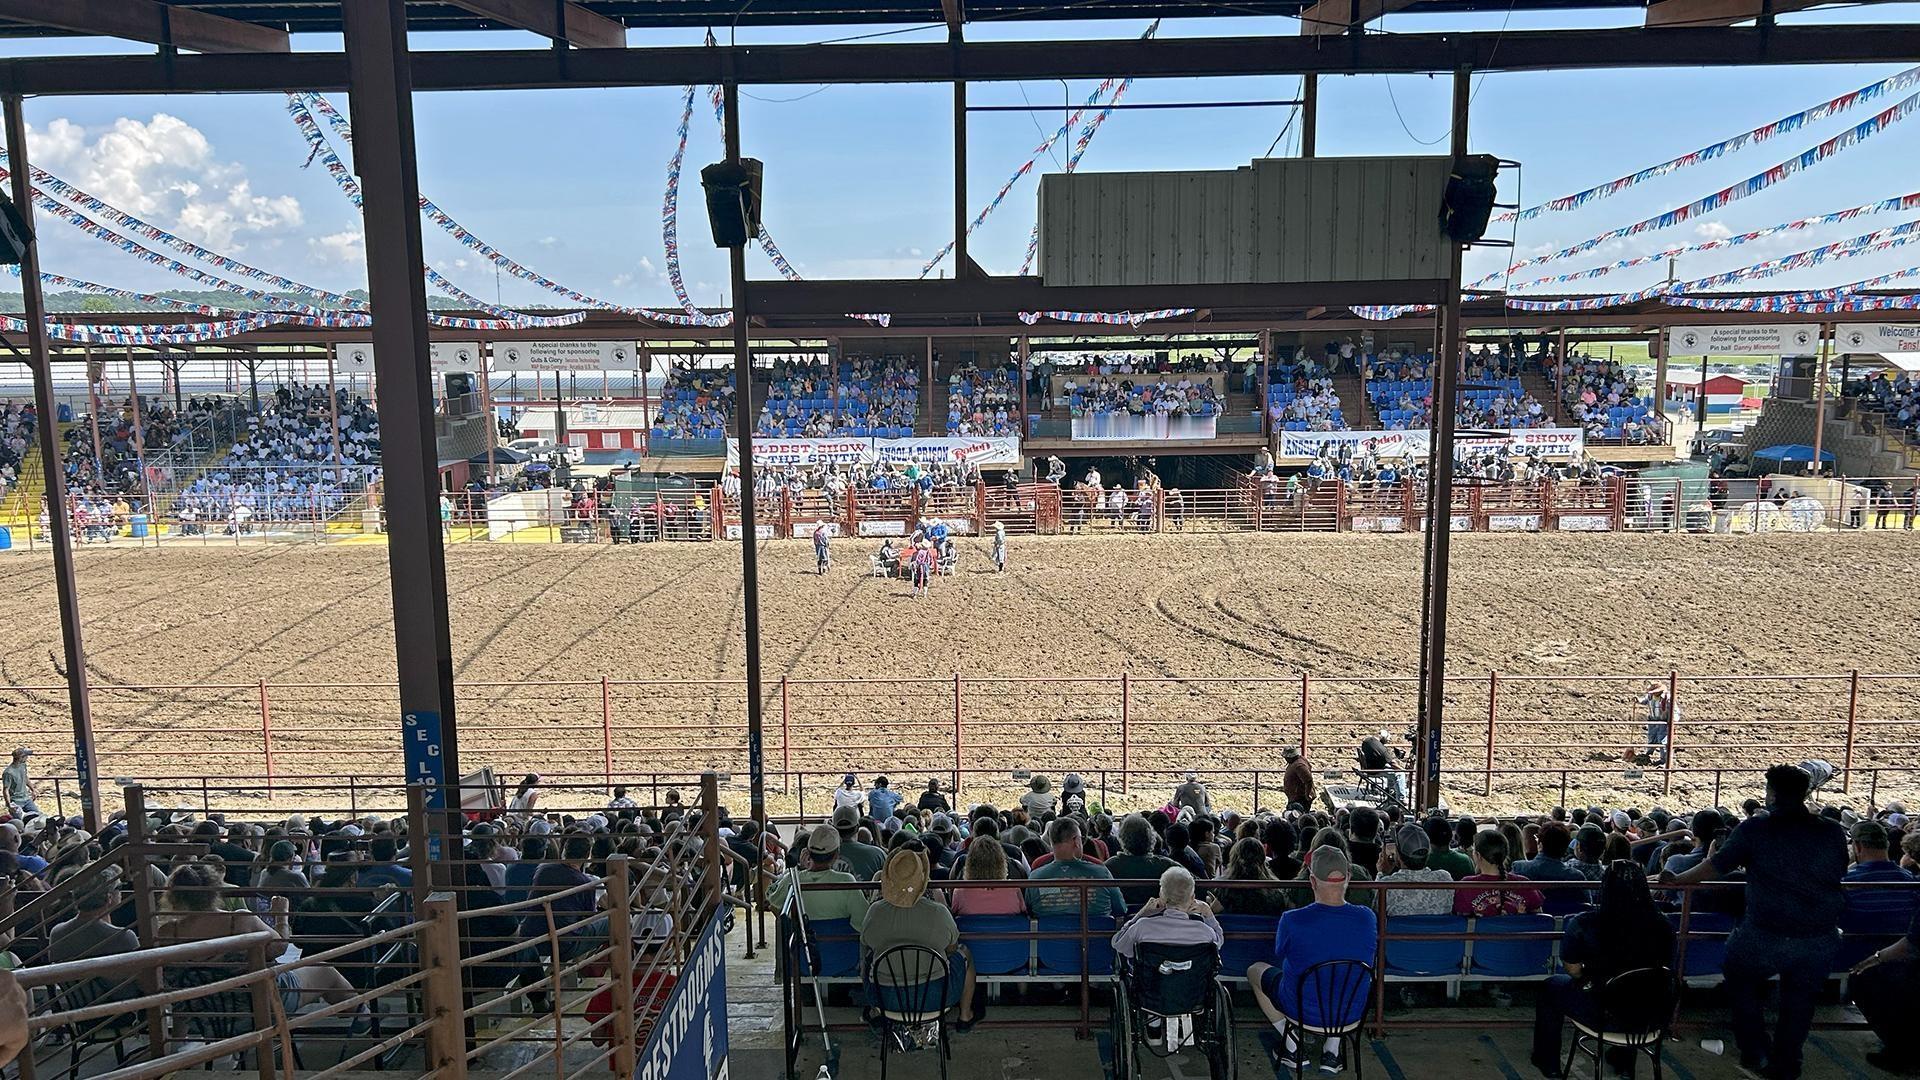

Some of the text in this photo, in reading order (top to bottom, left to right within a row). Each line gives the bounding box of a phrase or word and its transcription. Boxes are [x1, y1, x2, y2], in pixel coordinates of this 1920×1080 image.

[1879, 326, 1915, 337] Welcome
[1711, 335, 1737, 343] following
[1898, 339, 1920, 350] Fans!
[1733, 344, 1752, 352] Danny
[1525, 434, 1577, 444] SHOW
[817, 443, 868, 454] SHOW
[768, 455, 800, 464] THE
[808, 453, 862, 463] SOUTH
